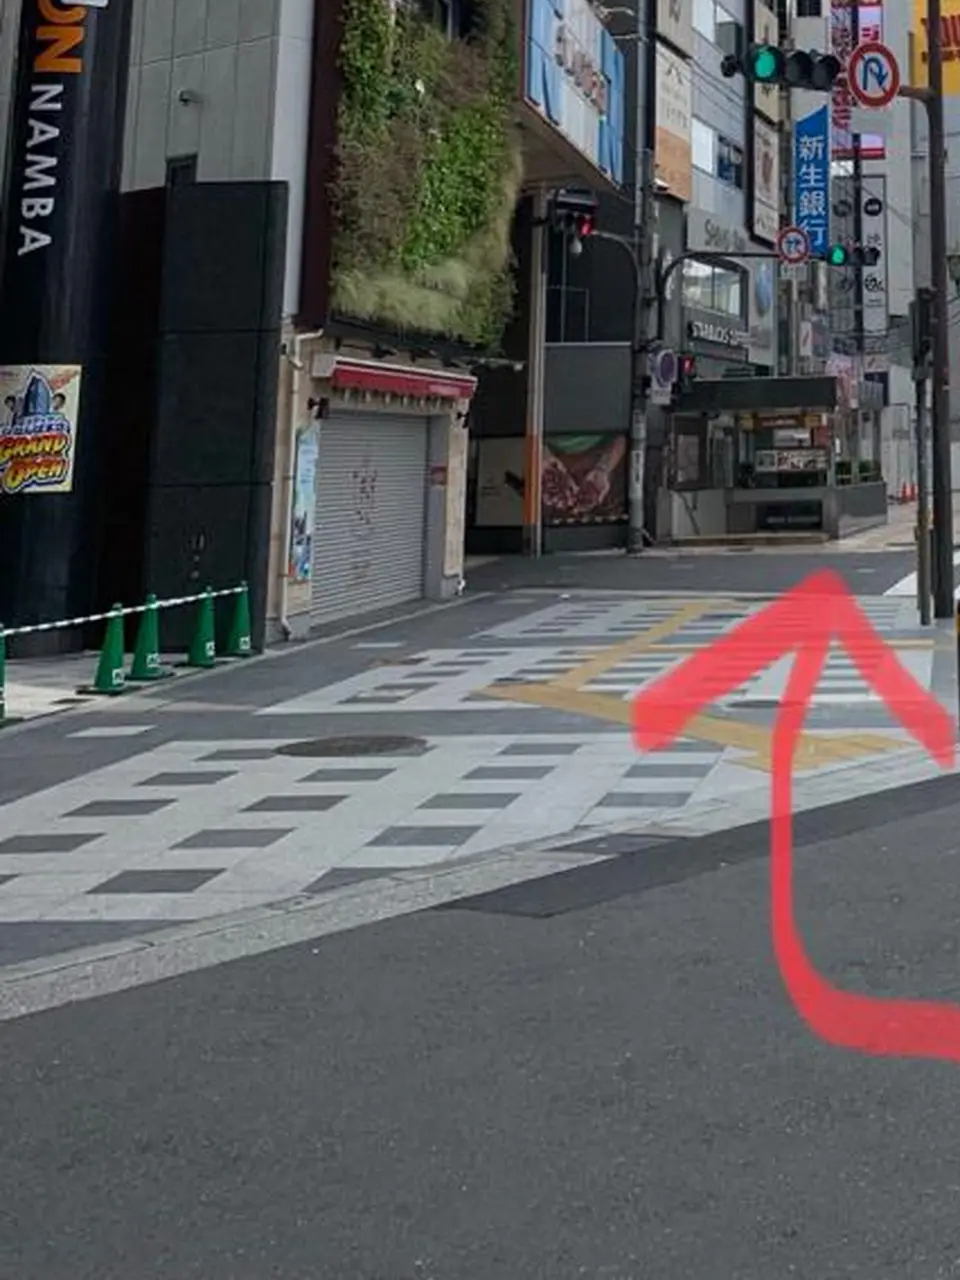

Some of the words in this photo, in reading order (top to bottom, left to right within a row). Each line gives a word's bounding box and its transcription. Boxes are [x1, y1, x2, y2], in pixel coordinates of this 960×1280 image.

[17, 83, 64, 257] NAMBA
[798, 134, 827, 246] 新生銀行
